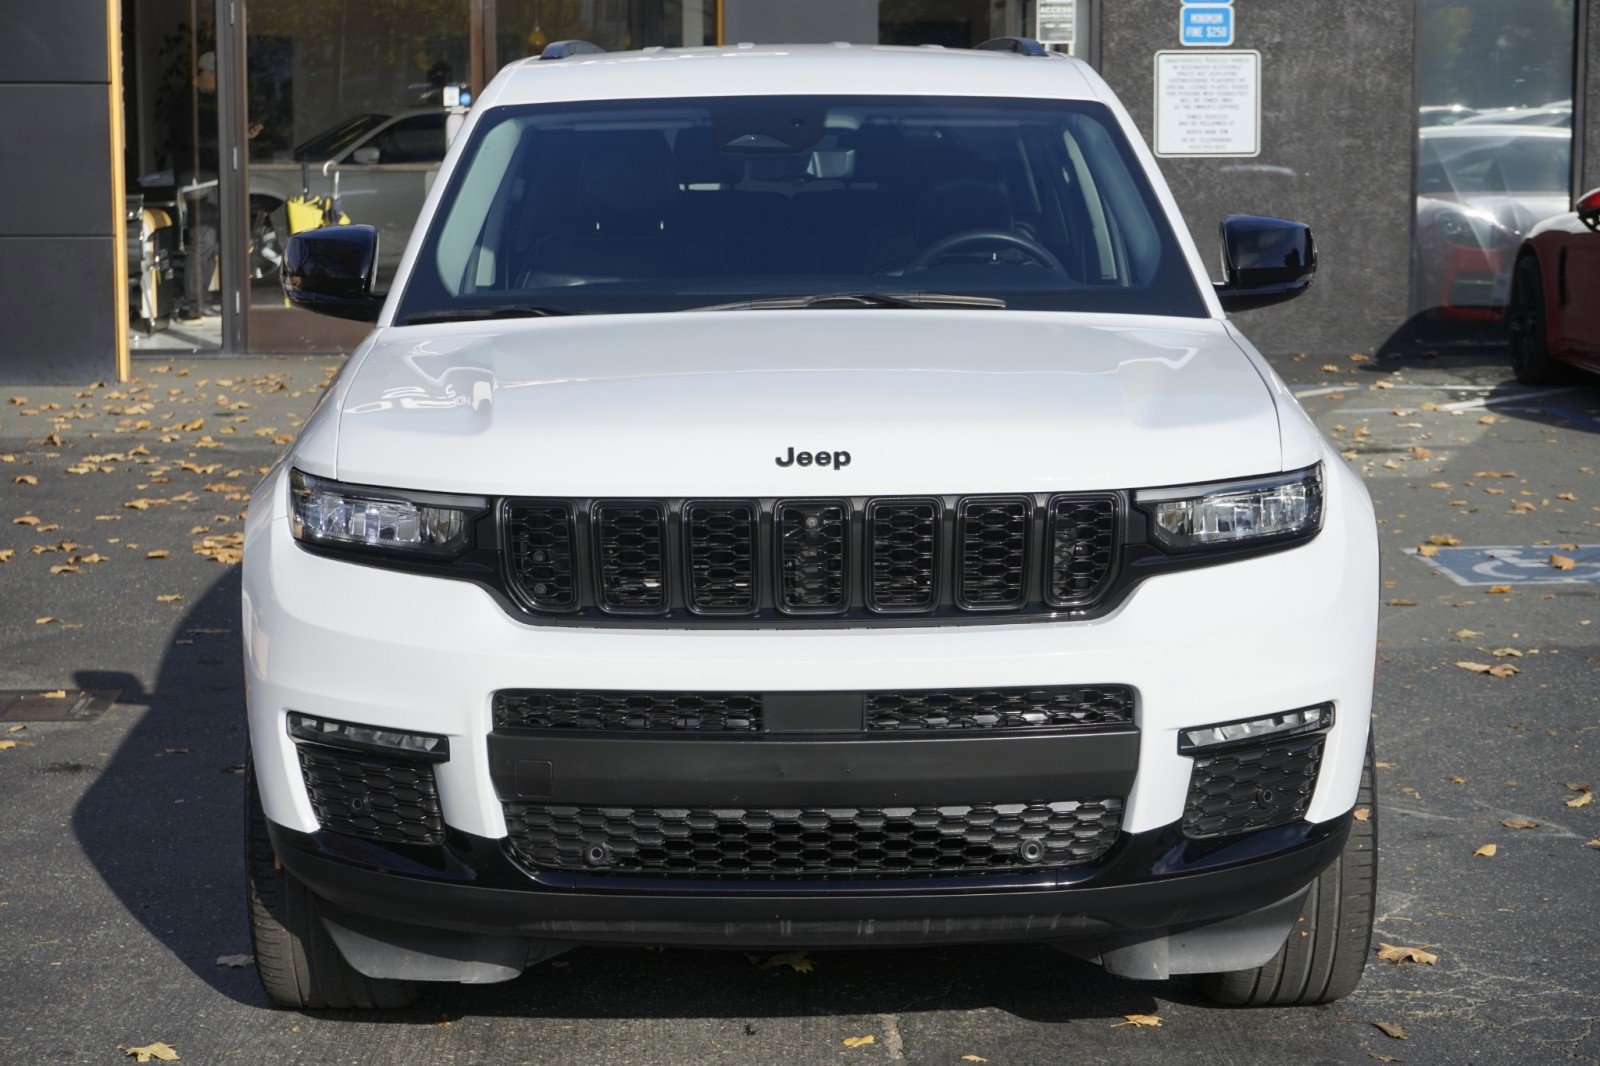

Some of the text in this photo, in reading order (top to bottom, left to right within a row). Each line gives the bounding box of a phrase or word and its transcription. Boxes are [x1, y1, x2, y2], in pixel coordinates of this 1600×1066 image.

[1190, 13, 1223, 24] MINIMUM
[1186, 26, 1228, 38] FINE $250
[775, 446, 851, 470] Jeep
